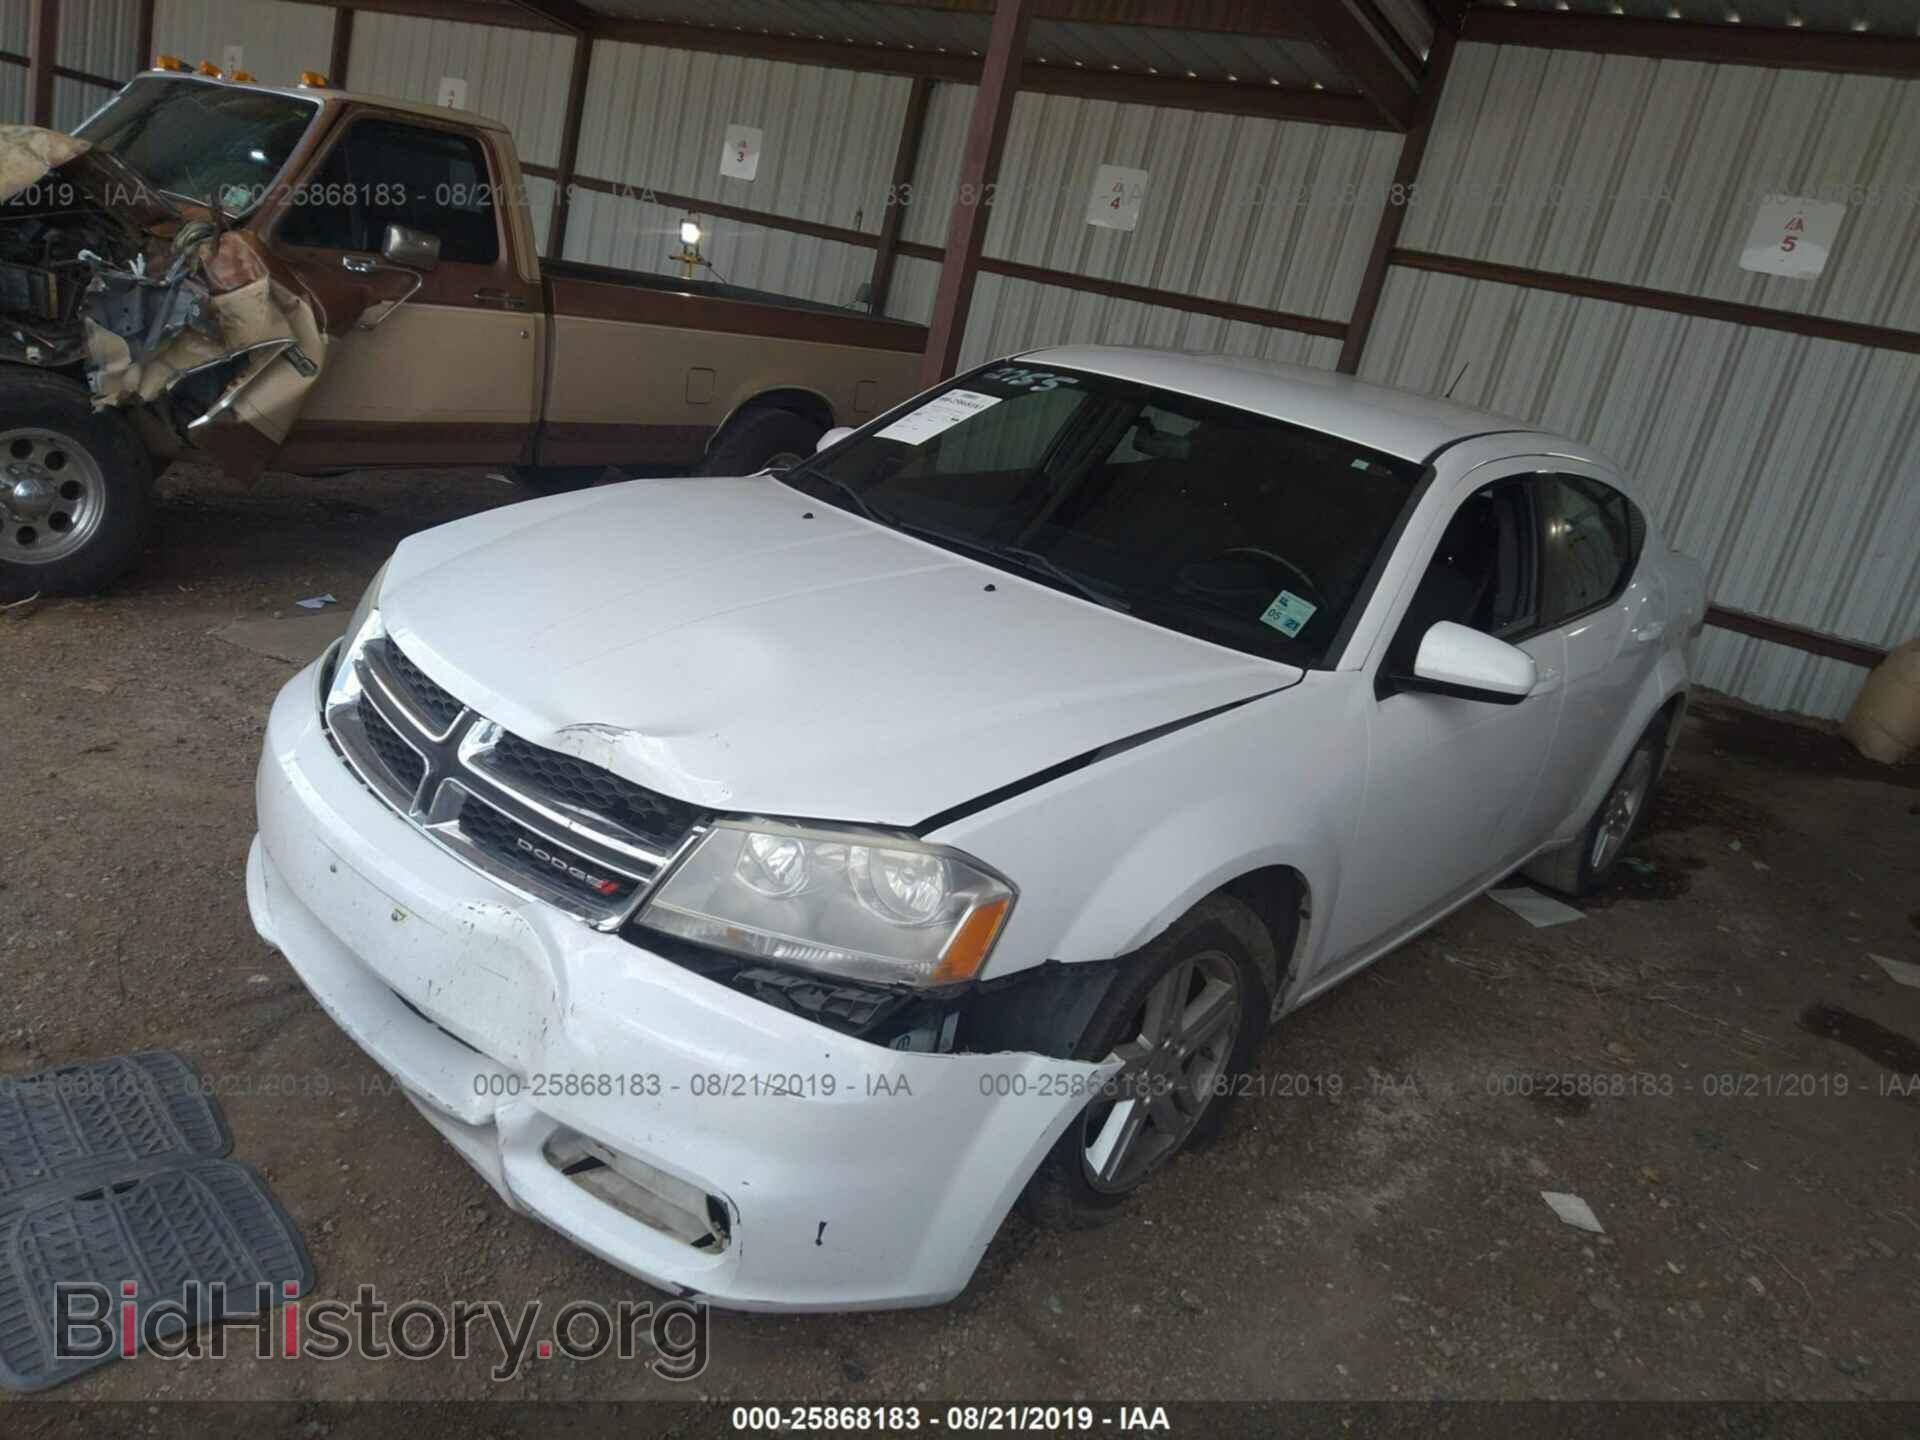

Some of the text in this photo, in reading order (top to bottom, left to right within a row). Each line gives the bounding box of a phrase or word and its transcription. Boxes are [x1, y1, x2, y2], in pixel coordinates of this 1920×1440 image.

[736, 151, 745, 163] 3
[1110, 196, 1121, 210] 4
[1779, 235, 1800, 253] 5
[516, 837, 605, 890] DODGE
